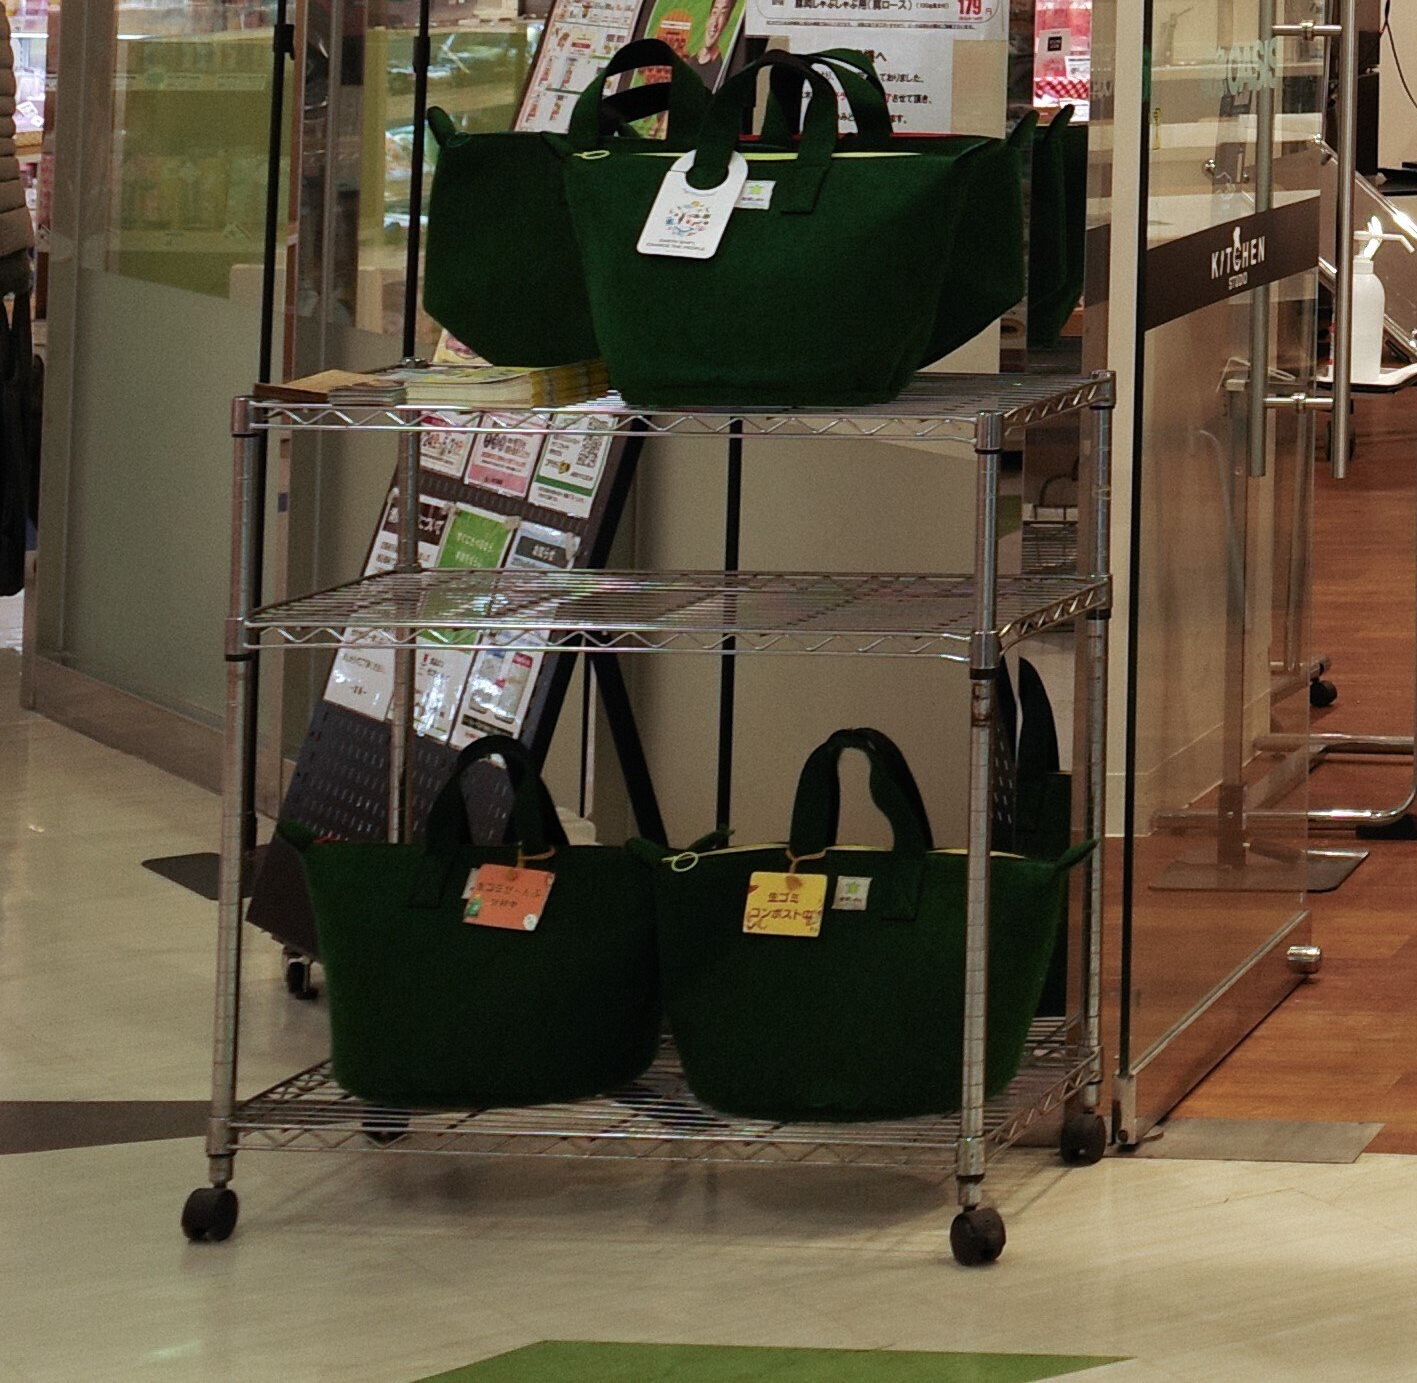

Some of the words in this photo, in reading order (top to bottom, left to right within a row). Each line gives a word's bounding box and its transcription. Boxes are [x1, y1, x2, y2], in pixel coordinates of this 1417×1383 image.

[1210, 235, 1266, 280] KITCHEN
[1228, 271, 1248, 291] STUDIO
[768, 892, 800, 904] 生ゴミ
